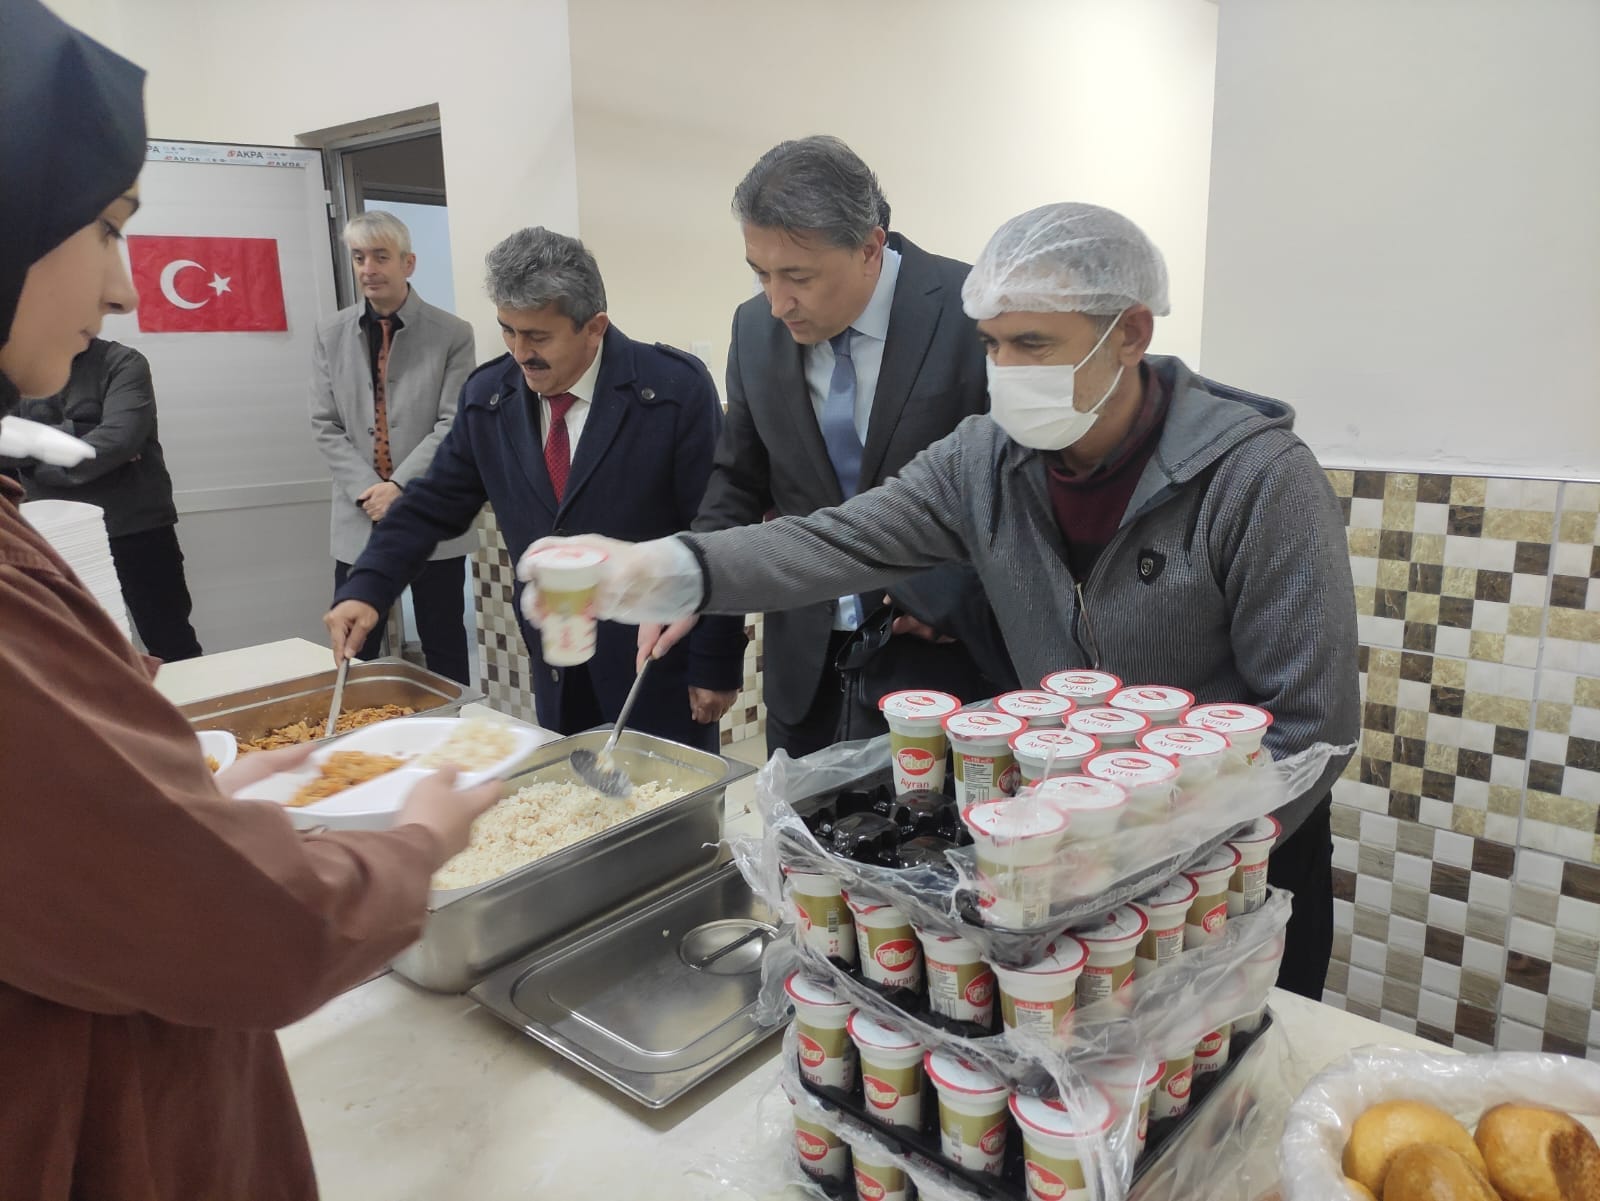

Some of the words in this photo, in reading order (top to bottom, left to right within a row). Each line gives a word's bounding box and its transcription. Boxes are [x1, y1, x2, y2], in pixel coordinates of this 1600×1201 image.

[236, 150, 264, 160] AKPA
[1061, 683, 1095, 692] Ayran
[1009, 701, 1043, 713] Ayran
[1078, 718, 1112, 729] Ayran
[1197, 716, 1231, 728] Ayran
[1154, 740, 1193, 751] Ayran
[901, 777, 929, 789] Ayran
